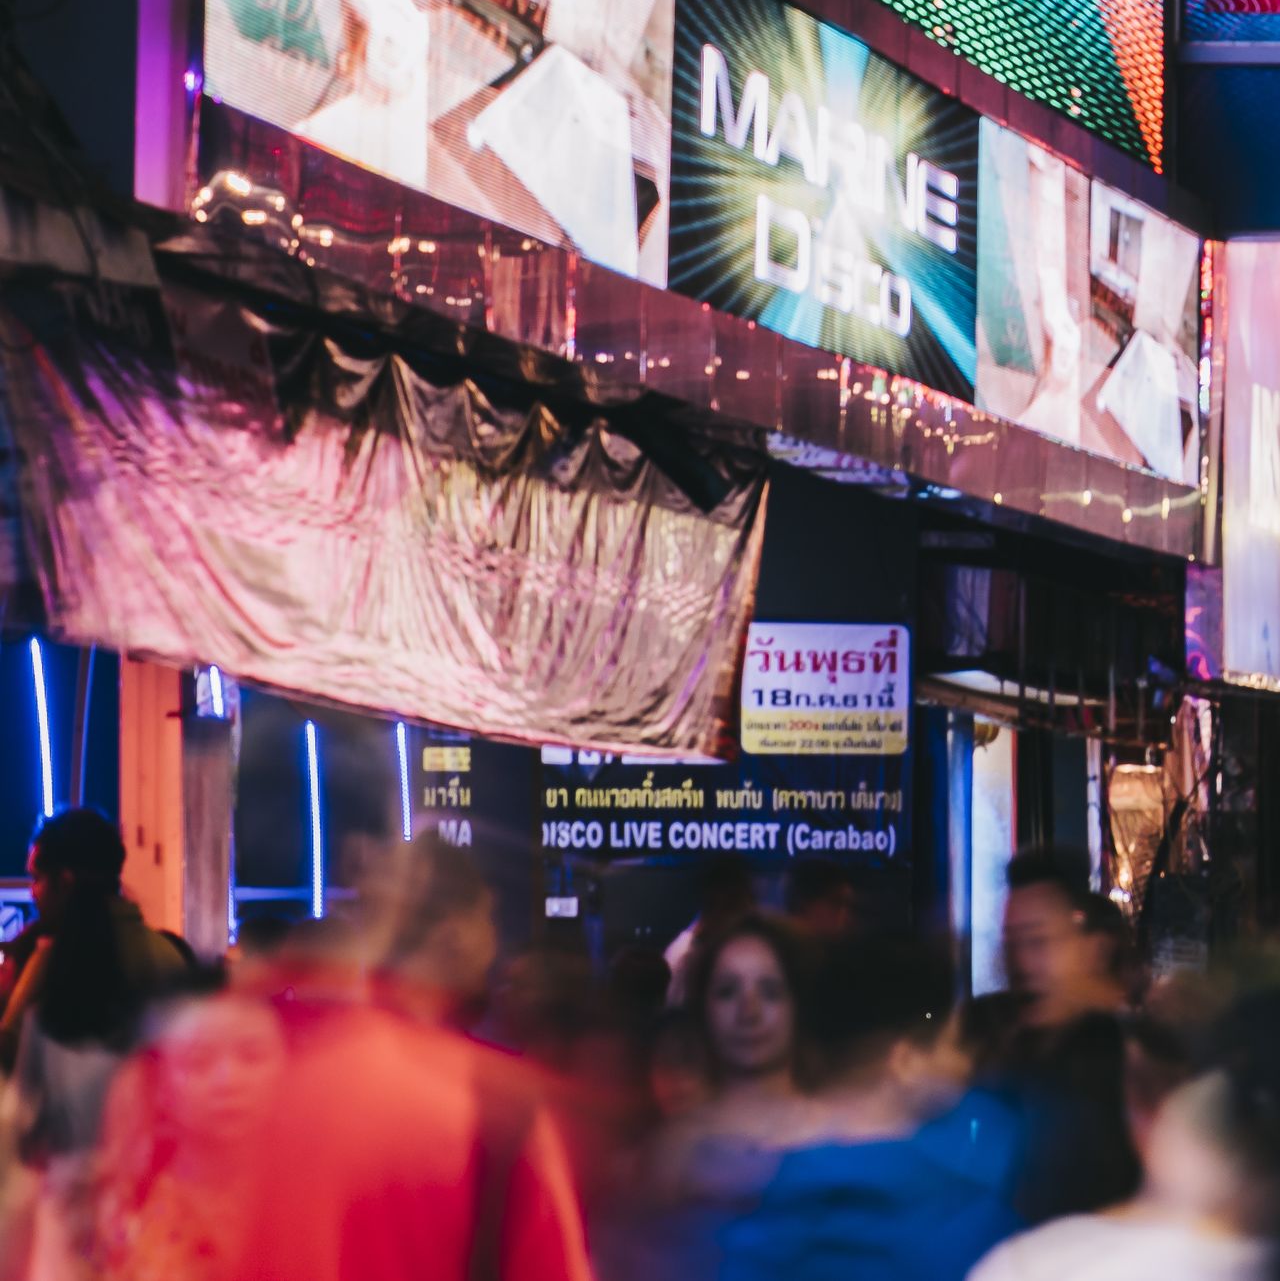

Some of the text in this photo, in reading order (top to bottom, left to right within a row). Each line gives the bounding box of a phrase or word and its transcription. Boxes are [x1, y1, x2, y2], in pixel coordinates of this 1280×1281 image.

[700, 43, 959, 254] MARINE
[748, 629, 899, 684] วันพุธที่
[610, 820, 663, 849] LIVE
[668, 821, 781, 850] CONCERT
[786, 822, 897, 857] (Carabao)
